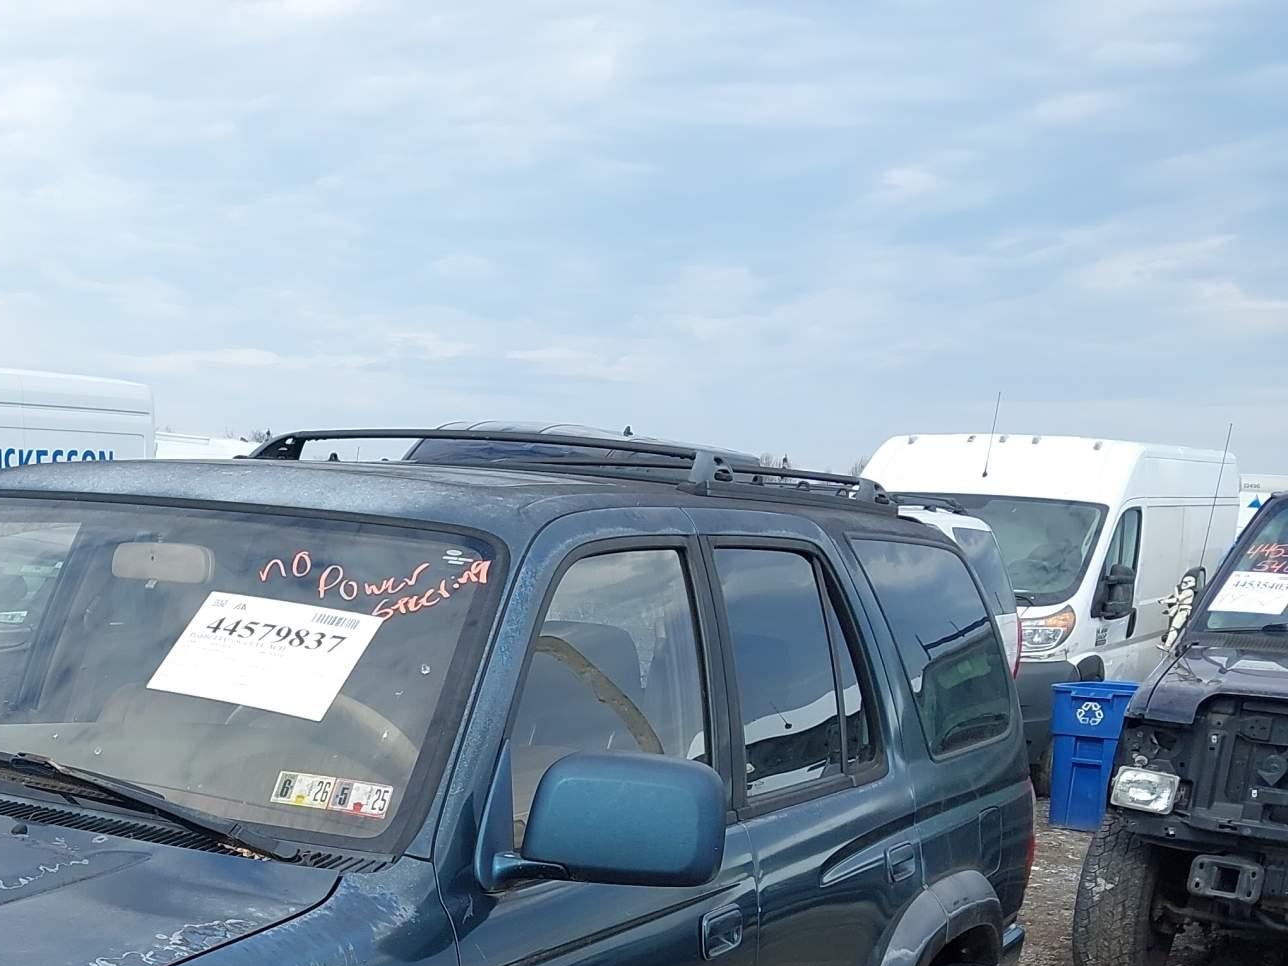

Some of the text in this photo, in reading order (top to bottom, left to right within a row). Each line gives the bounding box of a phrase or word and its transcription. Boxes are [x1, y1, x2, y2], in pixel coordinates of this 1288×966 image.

[1247, 543, 1288, 559] 445
[259, 551, 312, 582] no
[206, 616, 349, 653] 44579837
[279, 779, 332, 803] 6 26
[371, 789, 390, 811] 25
